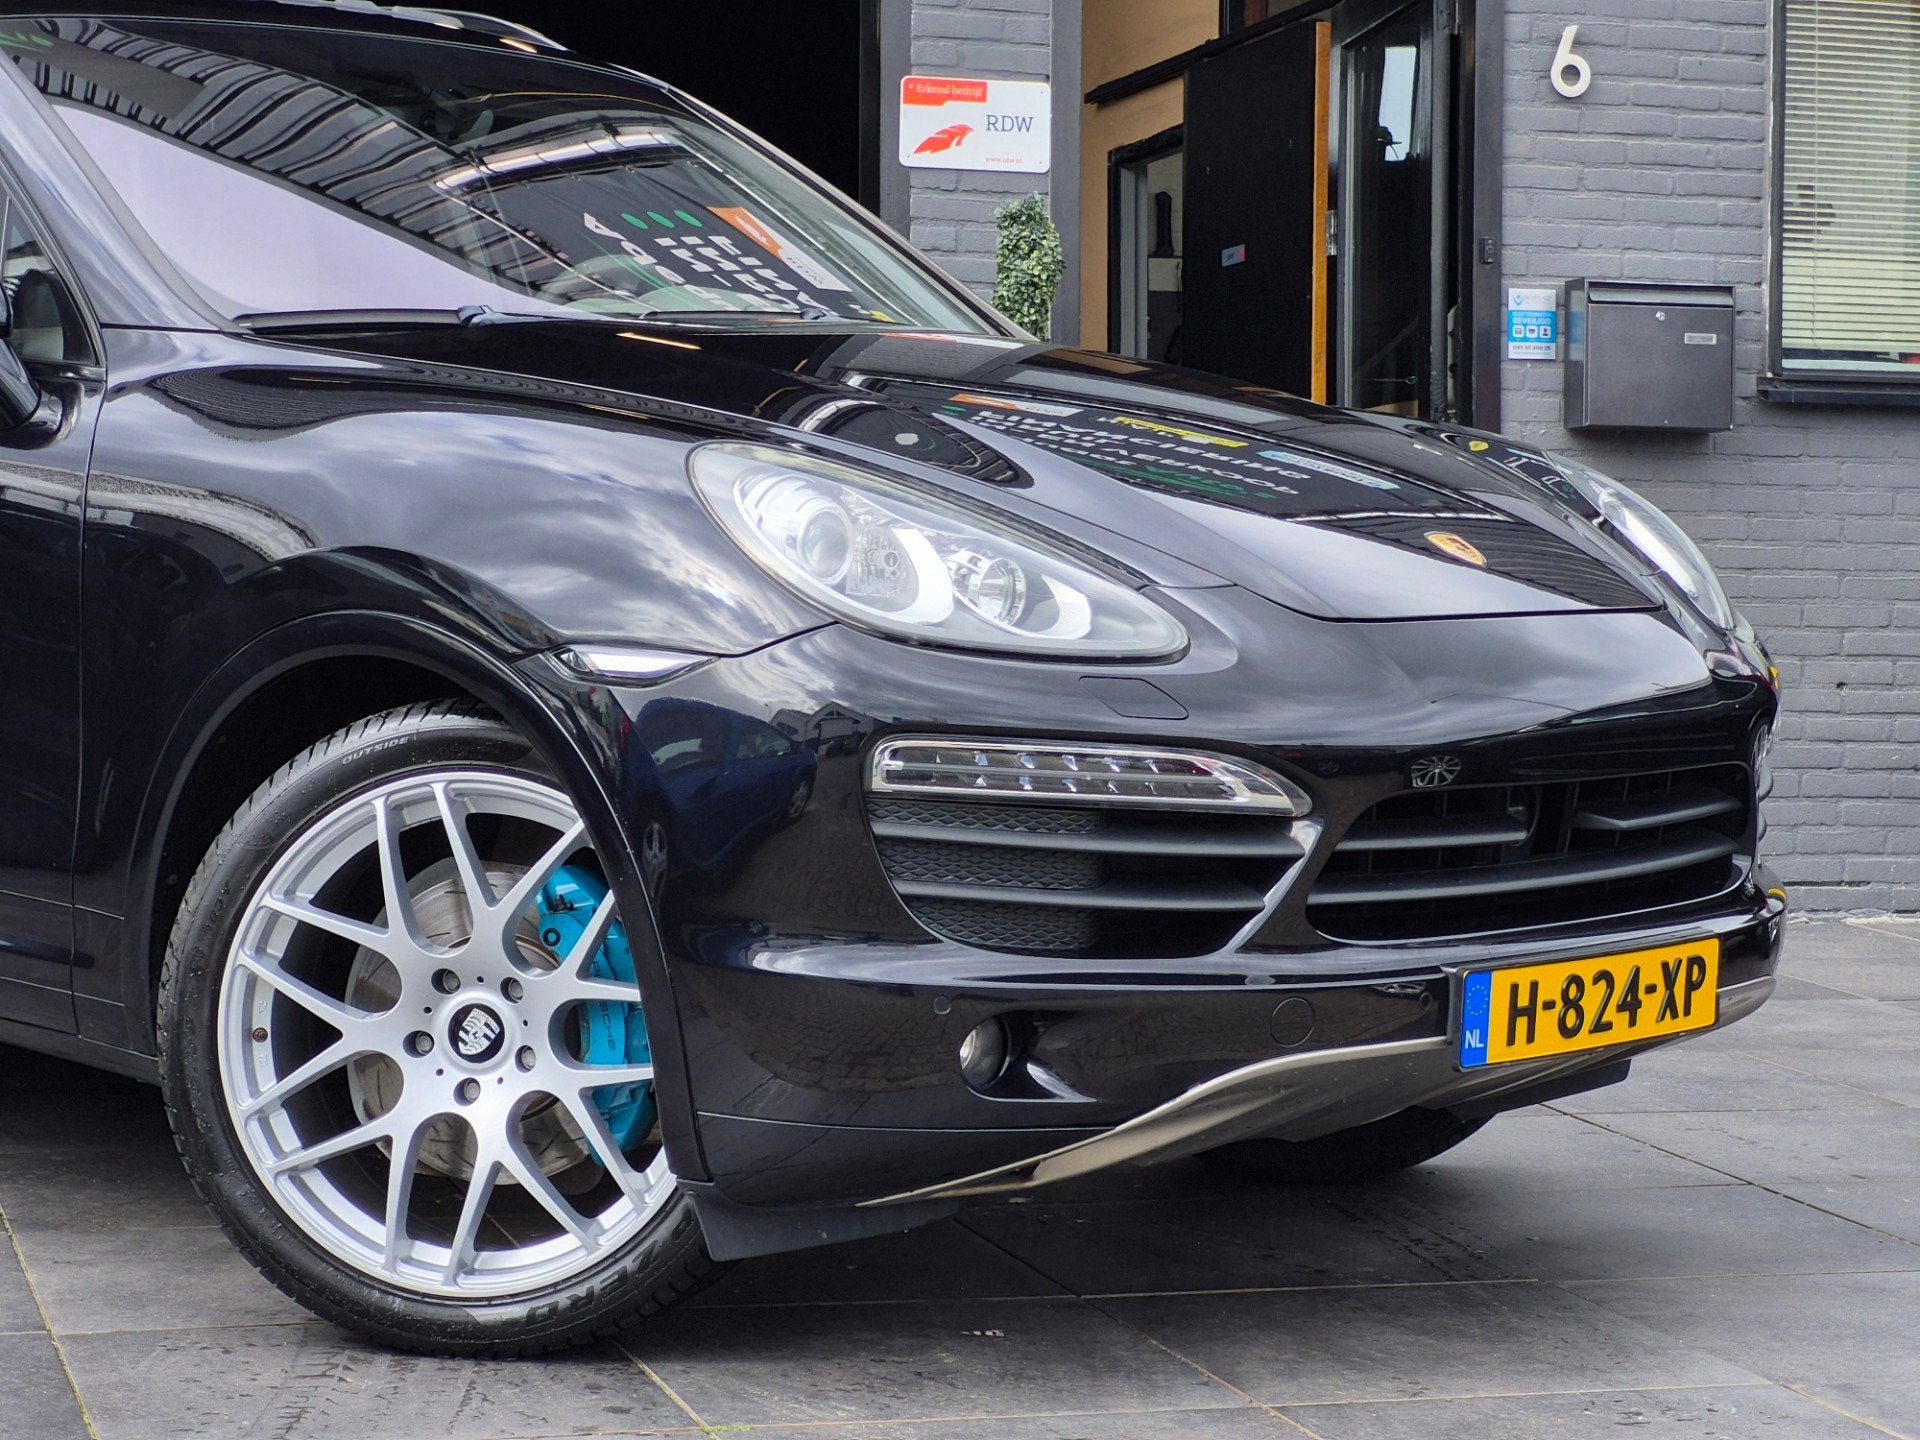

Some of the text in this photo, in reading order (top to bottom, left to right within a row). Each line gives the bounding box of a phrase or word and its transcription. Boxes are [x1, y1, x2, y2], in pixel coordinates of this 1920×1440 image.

[1550, 25, 1591, 98] 6
[916, 83, 983, 98] Erkend bedrijf
[985, 114, 1034, 133] RDW
[342, 736, 410, 765] OUTSIDE
[592, 960, 617, 1053] PSCHE
[1506, 954, 1707, 1047] H-824-XP
[1464, 1028, 1485, 1050] NL
